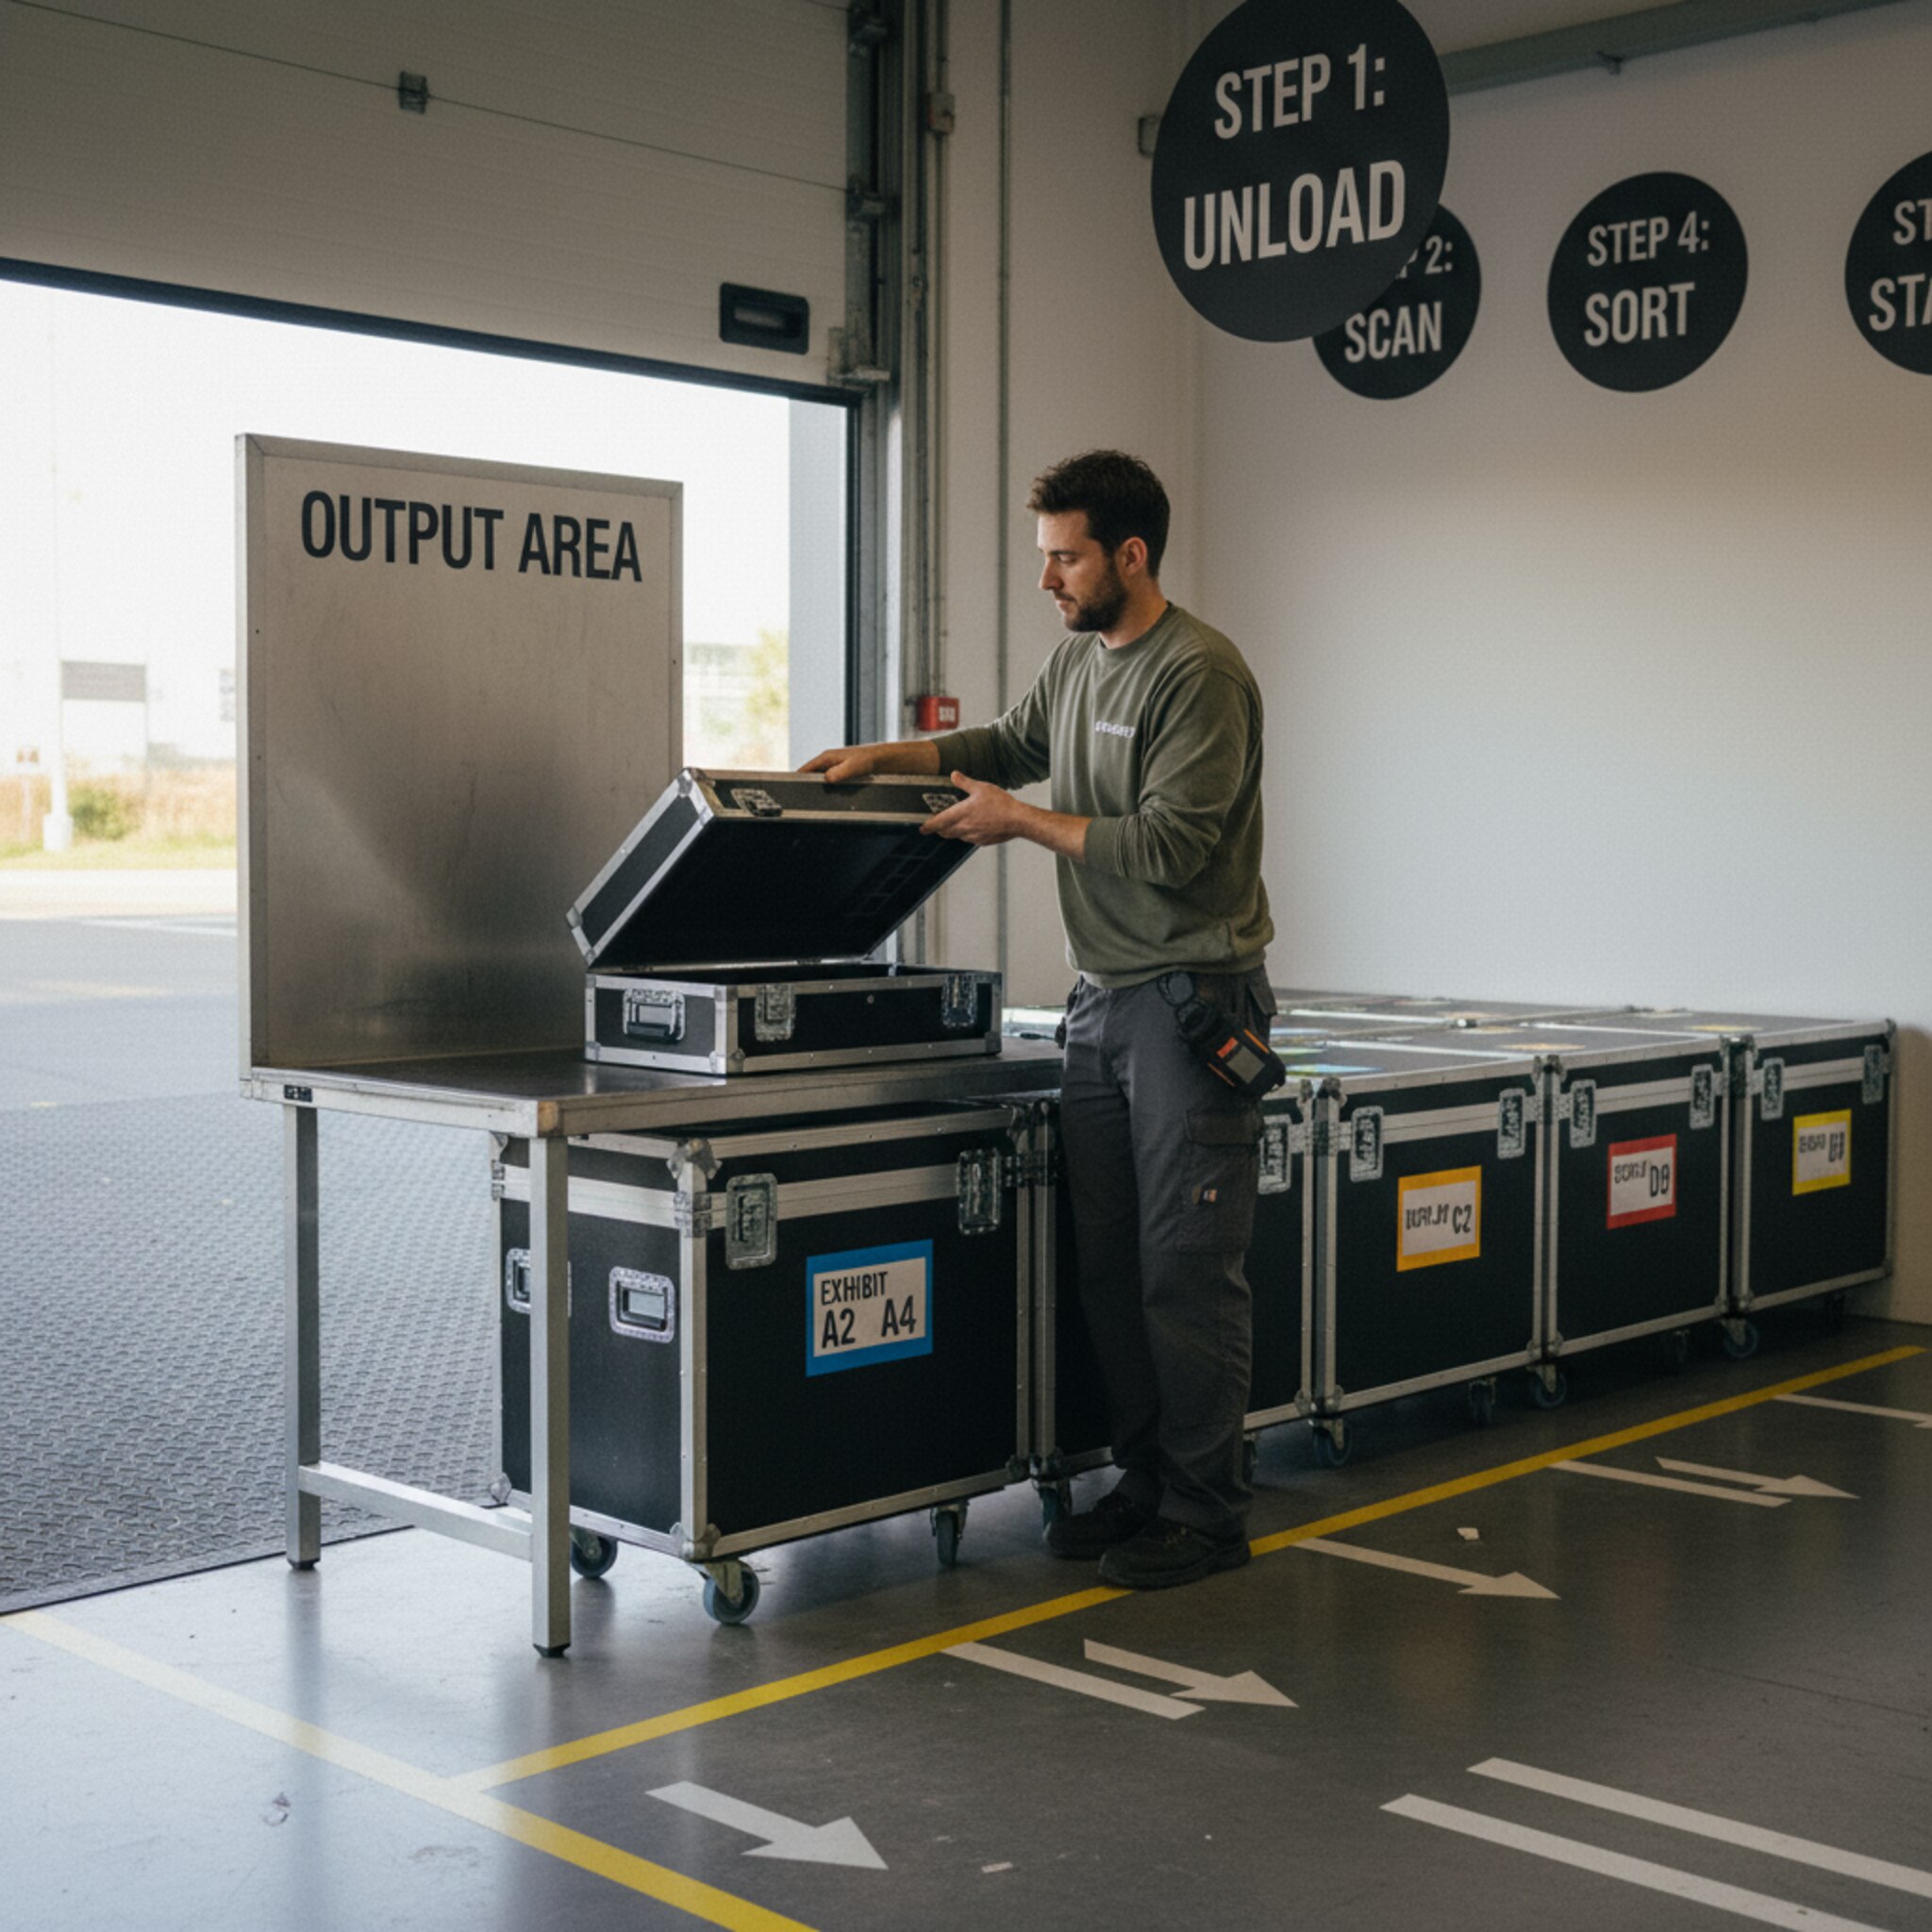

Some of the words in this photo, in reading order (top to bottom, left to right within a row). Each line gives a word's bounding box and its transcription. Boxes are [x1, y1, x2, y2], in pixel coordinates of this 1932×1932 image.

[1214, 53, 1331, 140] STEP
[1347, 43, 1386, 110] 1:
[1184, 159, 1406, 271] UNLOAD
[1587, 216, 1670, 267] STEP
[1677, 210, 1710, 254] 4:
[1424, 235, 1454, 275] 2:
[1343, 301, 1442, 363] SCAN
[1584, 282, 1695, 347] SORT
[301, 490, 505, 571] OUTPUT
[518, 512, 643, 582] AREA
[820, 1271, 889, 1306] EXHIBIT
[822, 1308, 856, 1349] A2
[881, 1294, 917, 1338] A4
